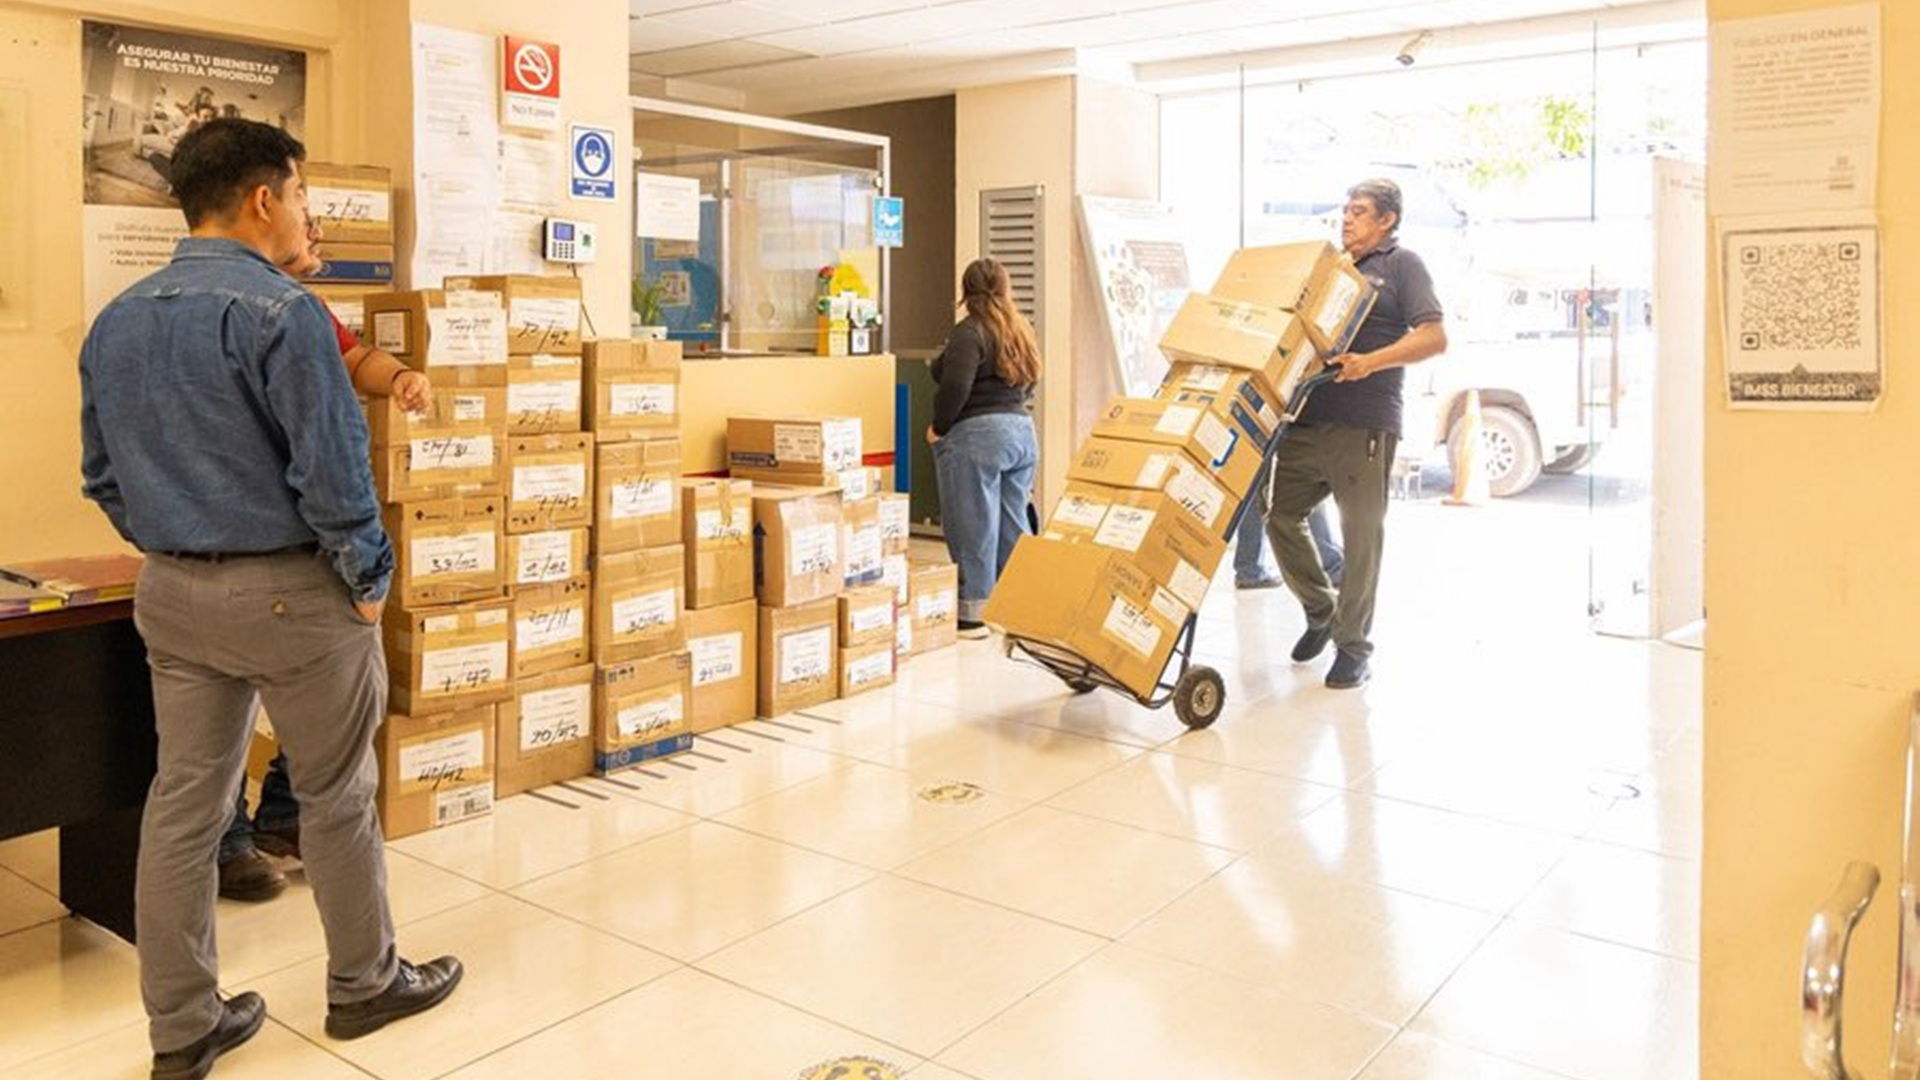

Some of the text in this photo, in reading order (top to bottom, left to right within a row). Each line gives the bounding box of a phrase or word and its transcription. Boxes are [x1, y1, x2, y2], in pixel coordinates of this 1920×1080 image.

[116, 43, 281, 76] ASEGURAR TU BIENESTAR
[123, 57, 275, 86] ES NUESTRA PRIORIDAD
[1780, 383, 1857, 398] BIENESTAR
